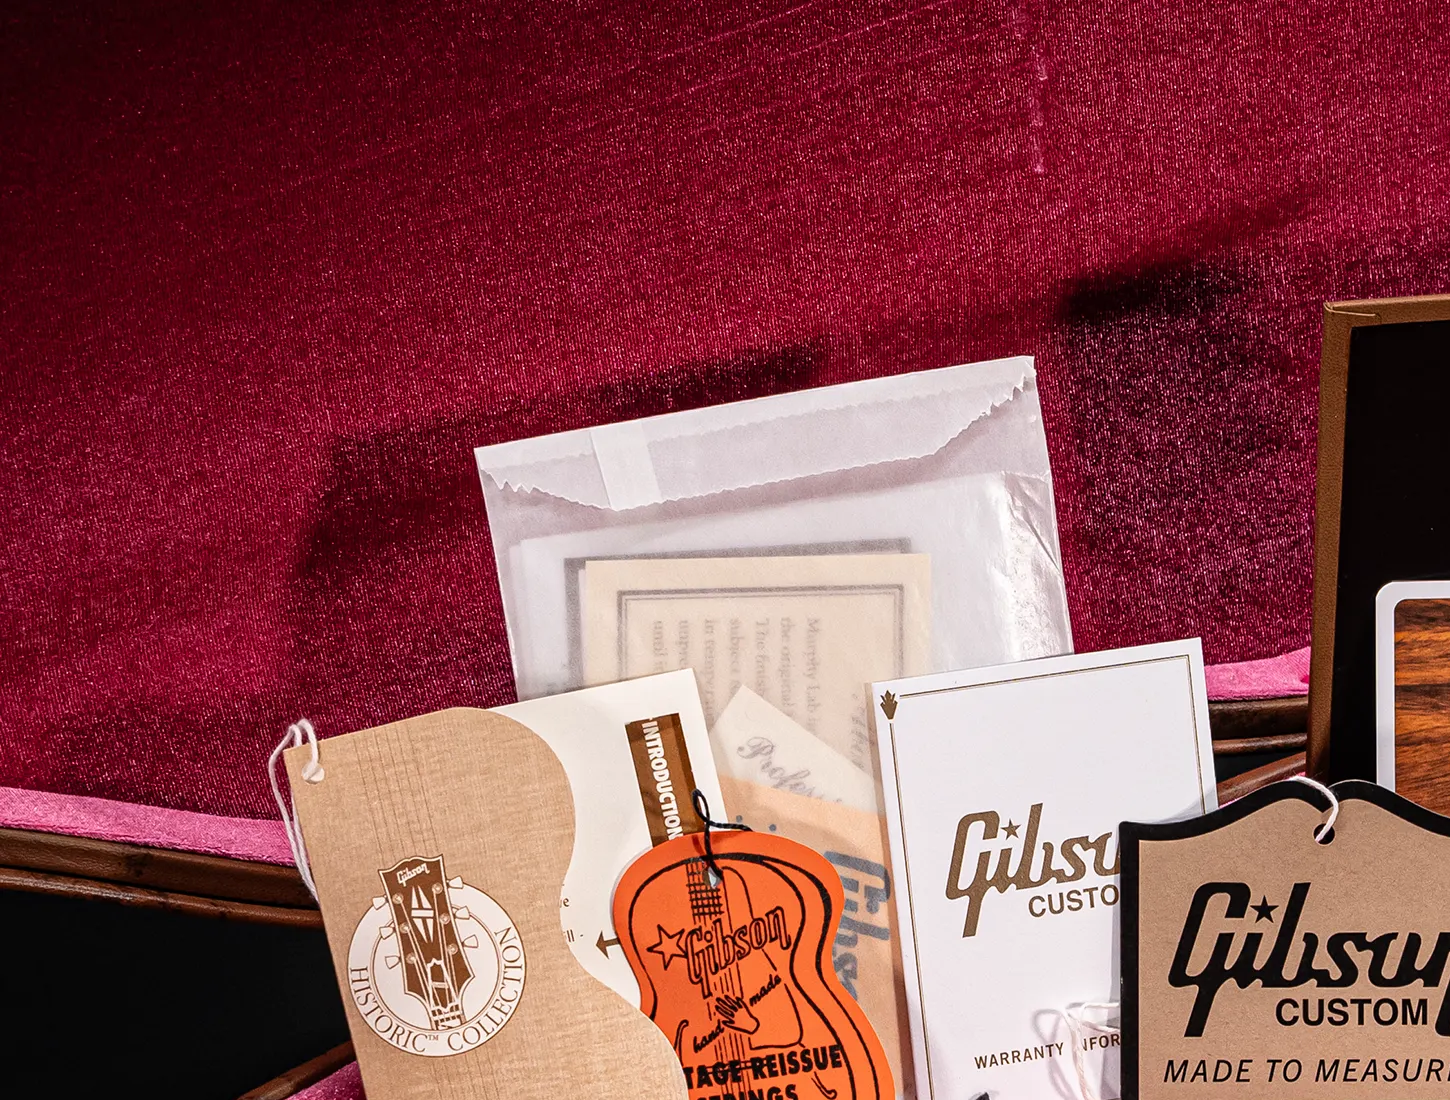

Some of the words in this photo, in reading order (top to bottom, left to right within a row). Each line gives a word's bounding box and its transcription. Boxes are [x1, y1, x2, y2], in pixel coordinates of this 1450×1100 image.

[396, 862, 430, 887] Gibson
[1029, 883, 1120, 919] CUSTO
[685, 906, 792, 999] Gibson
[447, 926, 523, 1052] COLLECTION
[694, 1019, 725, 1053] hand
[749, 974, 781, 1007] made
[1275, 998, 1428, 1026] CUSTOM
[683, 1059, 743, 1090] TAGE
[750, 1044, 842, 1081] REISSUE
[974, 1042, 1064, 1070] WARRANTY
[1164, 1059, 1253, 1083] MADE
[1266, 1058, 1301, 1083] TO
